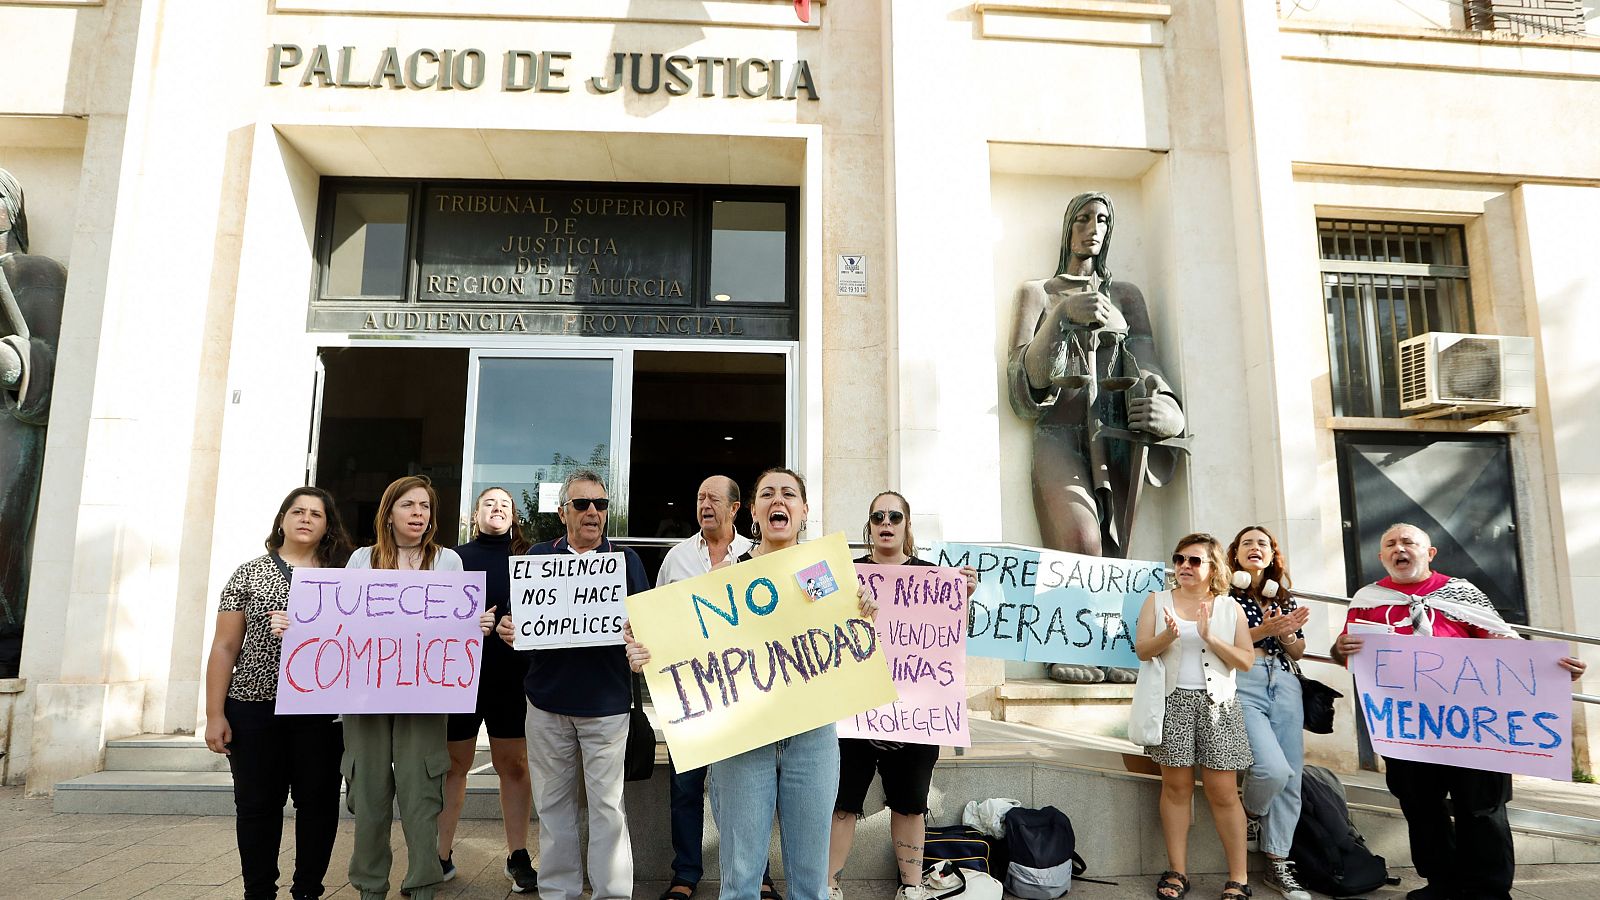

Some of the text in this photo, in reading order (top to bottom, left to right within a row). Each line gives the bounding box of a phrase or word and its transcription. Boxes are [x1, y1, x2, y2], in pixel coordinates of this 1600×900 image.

[266, 43, 820, 100] PALACIO DE JUSTICIA
[436, 195, 687, 217] TRIBUNAL SUPERIOR
[544, 218, 577, 234] DE
[501, 236, 618, 255] JUSTICIA
[516, 257, 601, 275] DE LA
[427, 276, 683, 297] REGION DE MURCIA
[363, 311, 528, 332] AUDIENCIA
[513, 556, 617, 579] EL SILENCIO
[917, 547, 1164, 594] MPRESAURIOS
[295, 580, 480, 623] JUECES
[521, 585, 622, 605] NOS HACE
[691, 577, 779, 639] NO
[894, 569, 963, 611] NIÑAS
[521, 613, 622, 637] CÓMPLICES
[889, 619, 962, 650] VENDEN
[967, 600, 1139, 653] DERASTA
[285, 624, 480, 692] CÓMPLICES
[659, 618, 876, 725] IMPUNIDAD
[1375, 649, 1537, 697] ERAN
[1363, 692, 1563, 750] MENORES
